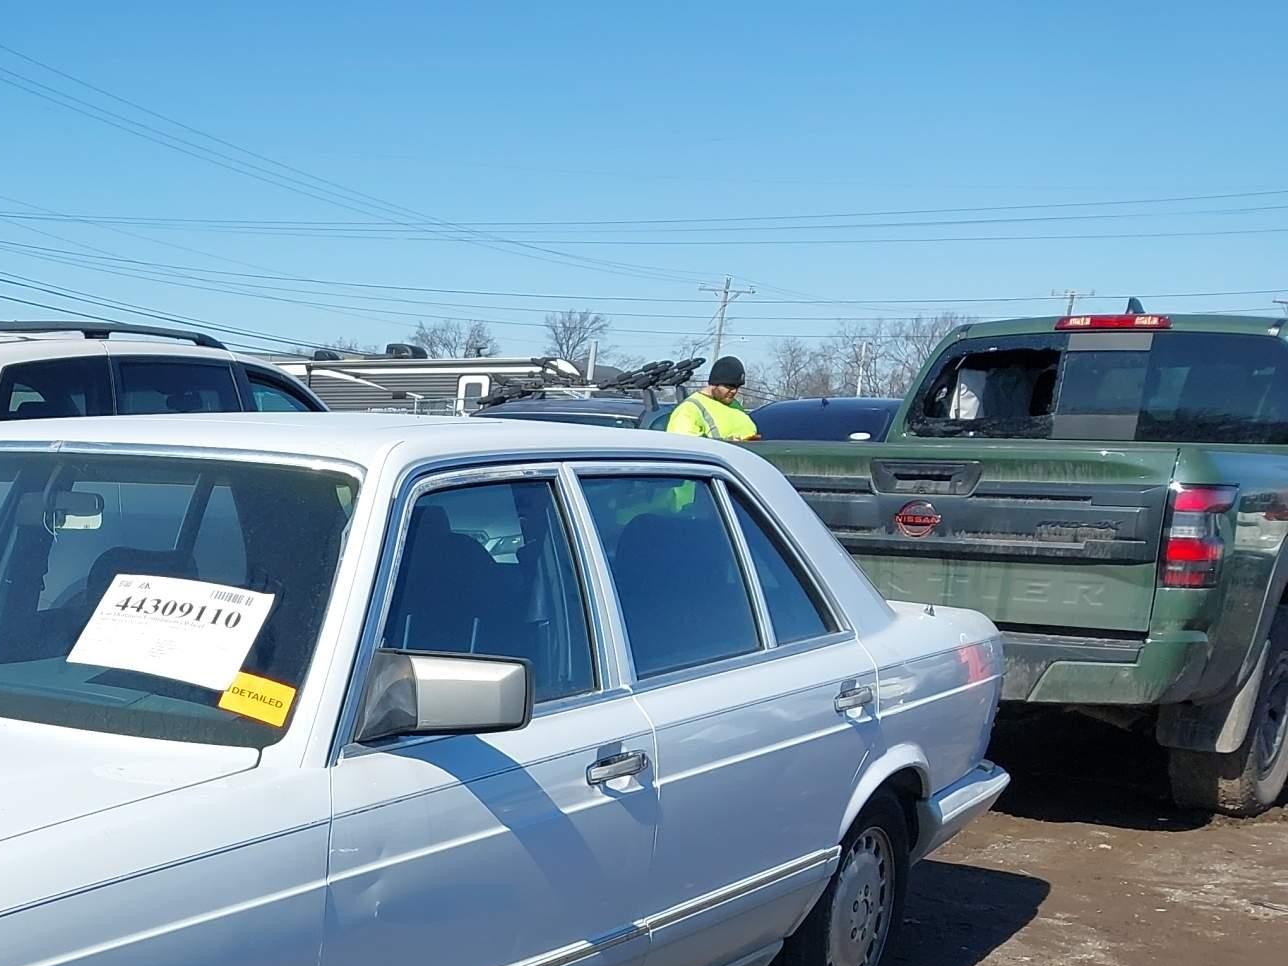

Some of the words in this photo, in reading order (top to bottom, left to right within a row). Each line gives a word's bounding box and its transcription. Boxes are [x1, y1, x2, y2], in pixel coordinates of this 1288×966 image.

[896, 515, 941, 524] NISSAN
[115, 596, 242, 628] 44309110
[231, 686, 284, 709] DETAILED
